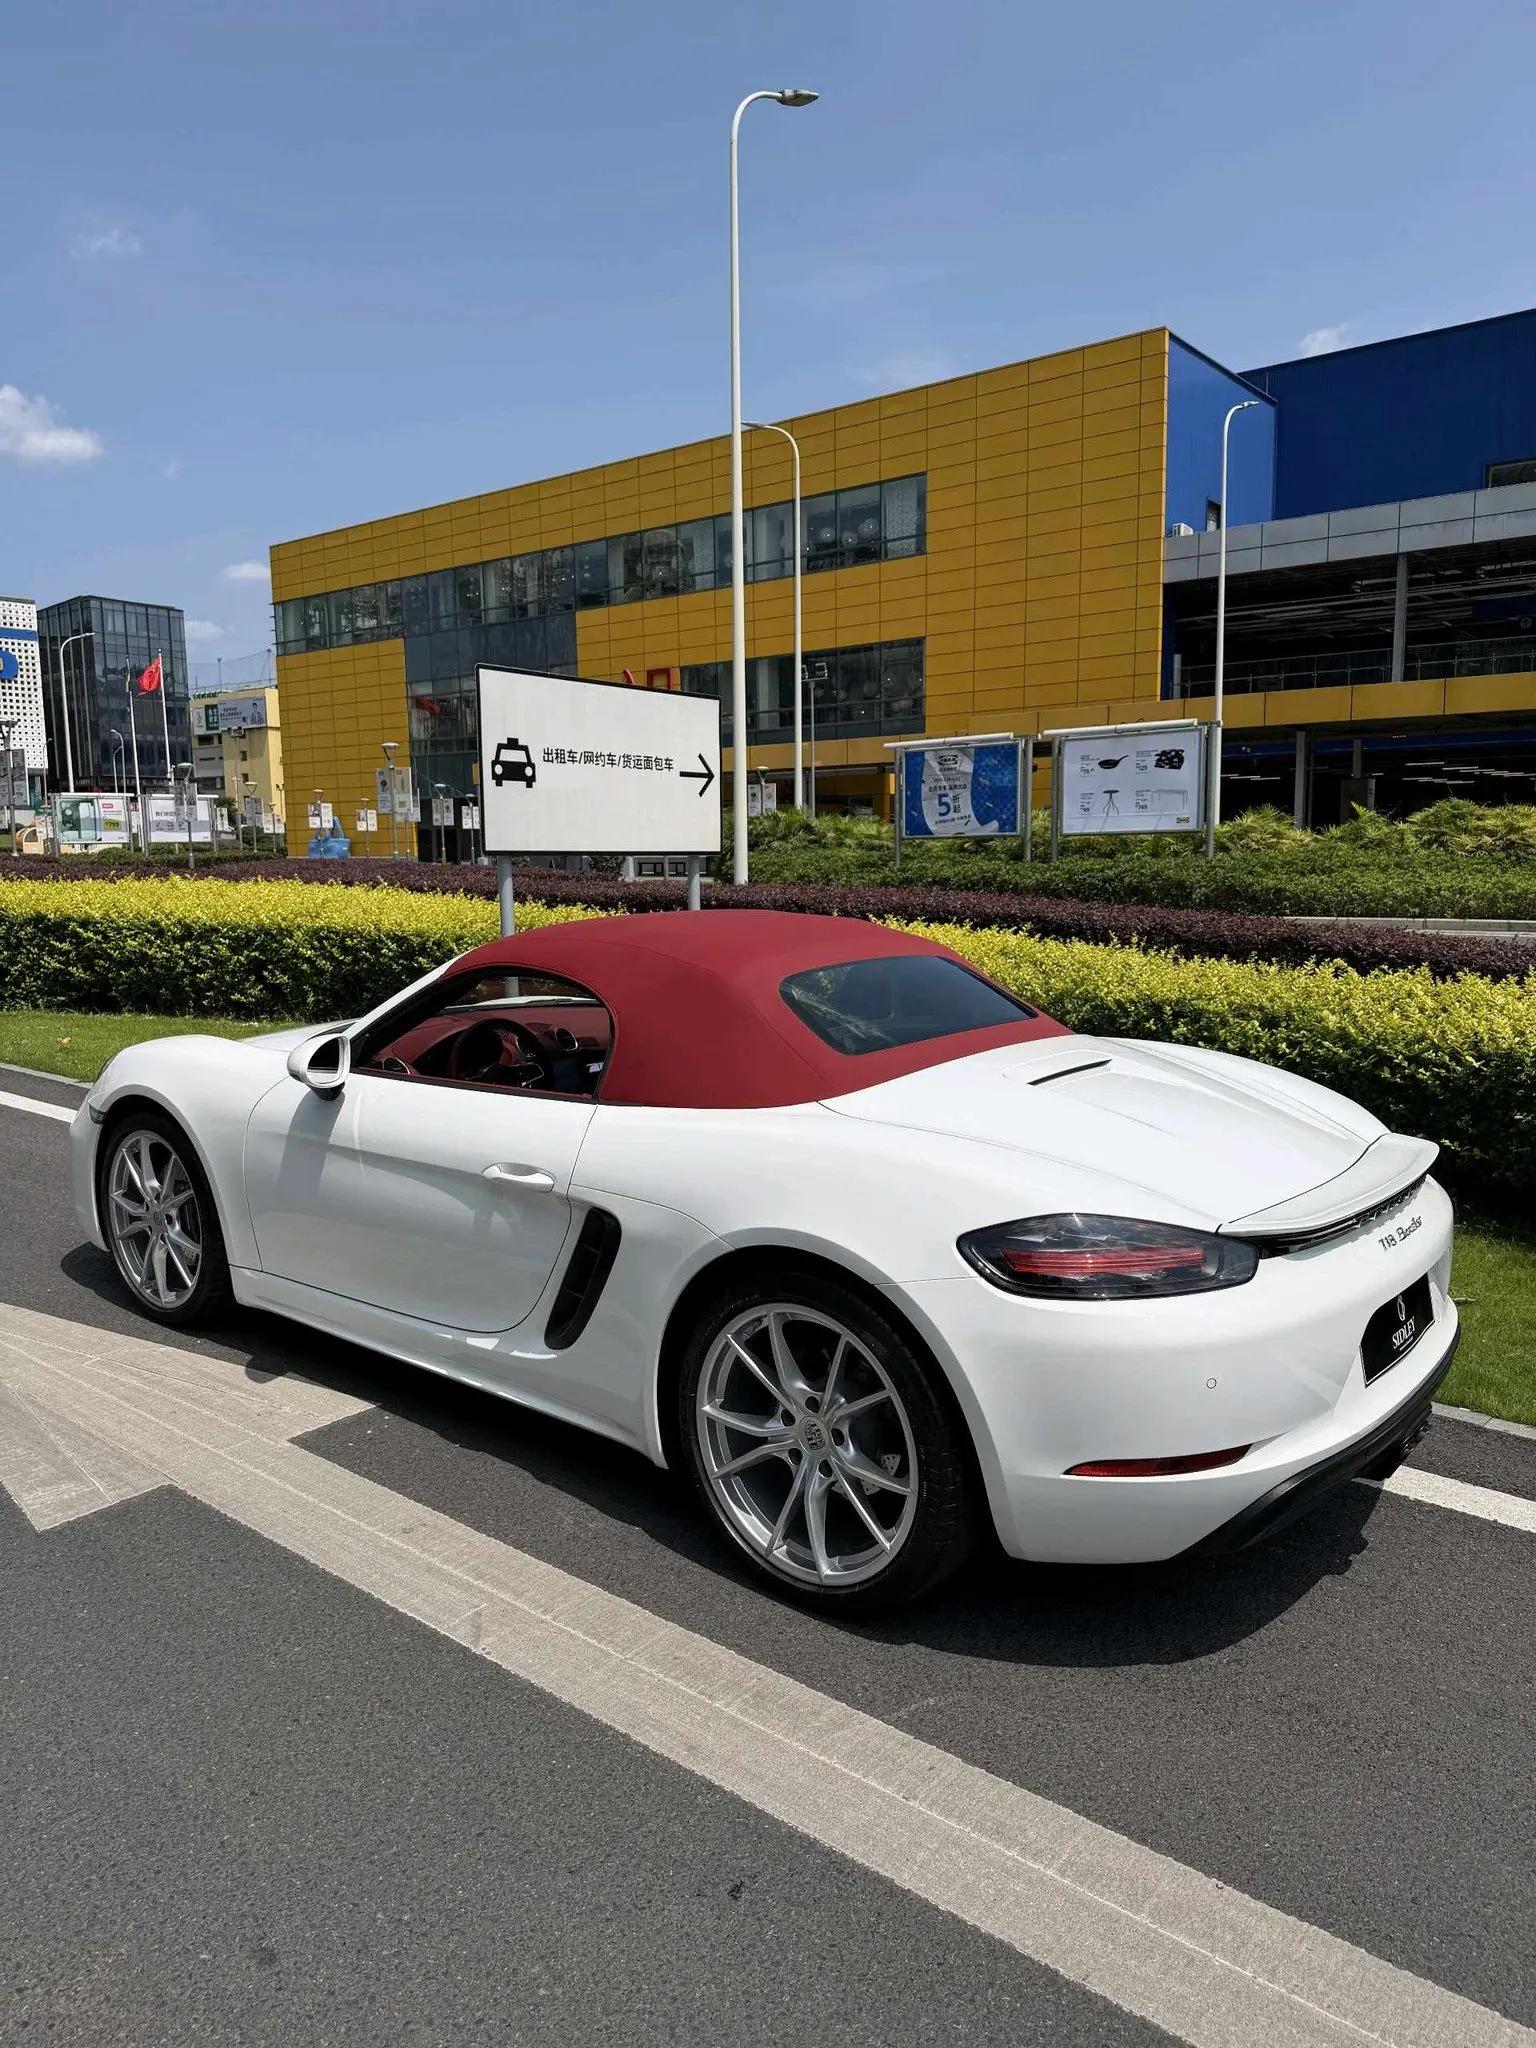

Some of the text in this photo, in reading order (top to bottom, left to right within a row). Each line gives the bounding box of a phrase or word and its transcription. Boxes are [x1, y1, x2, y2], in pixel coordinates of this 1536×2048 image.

[542, 747, 674, 772] 出租车/网约车/货运面包车
[939, 793, 951, 817] 5
[1378, 1234, 1397, 1252] 718
[1392, 1316, 1416, 1349] SIDLEY
